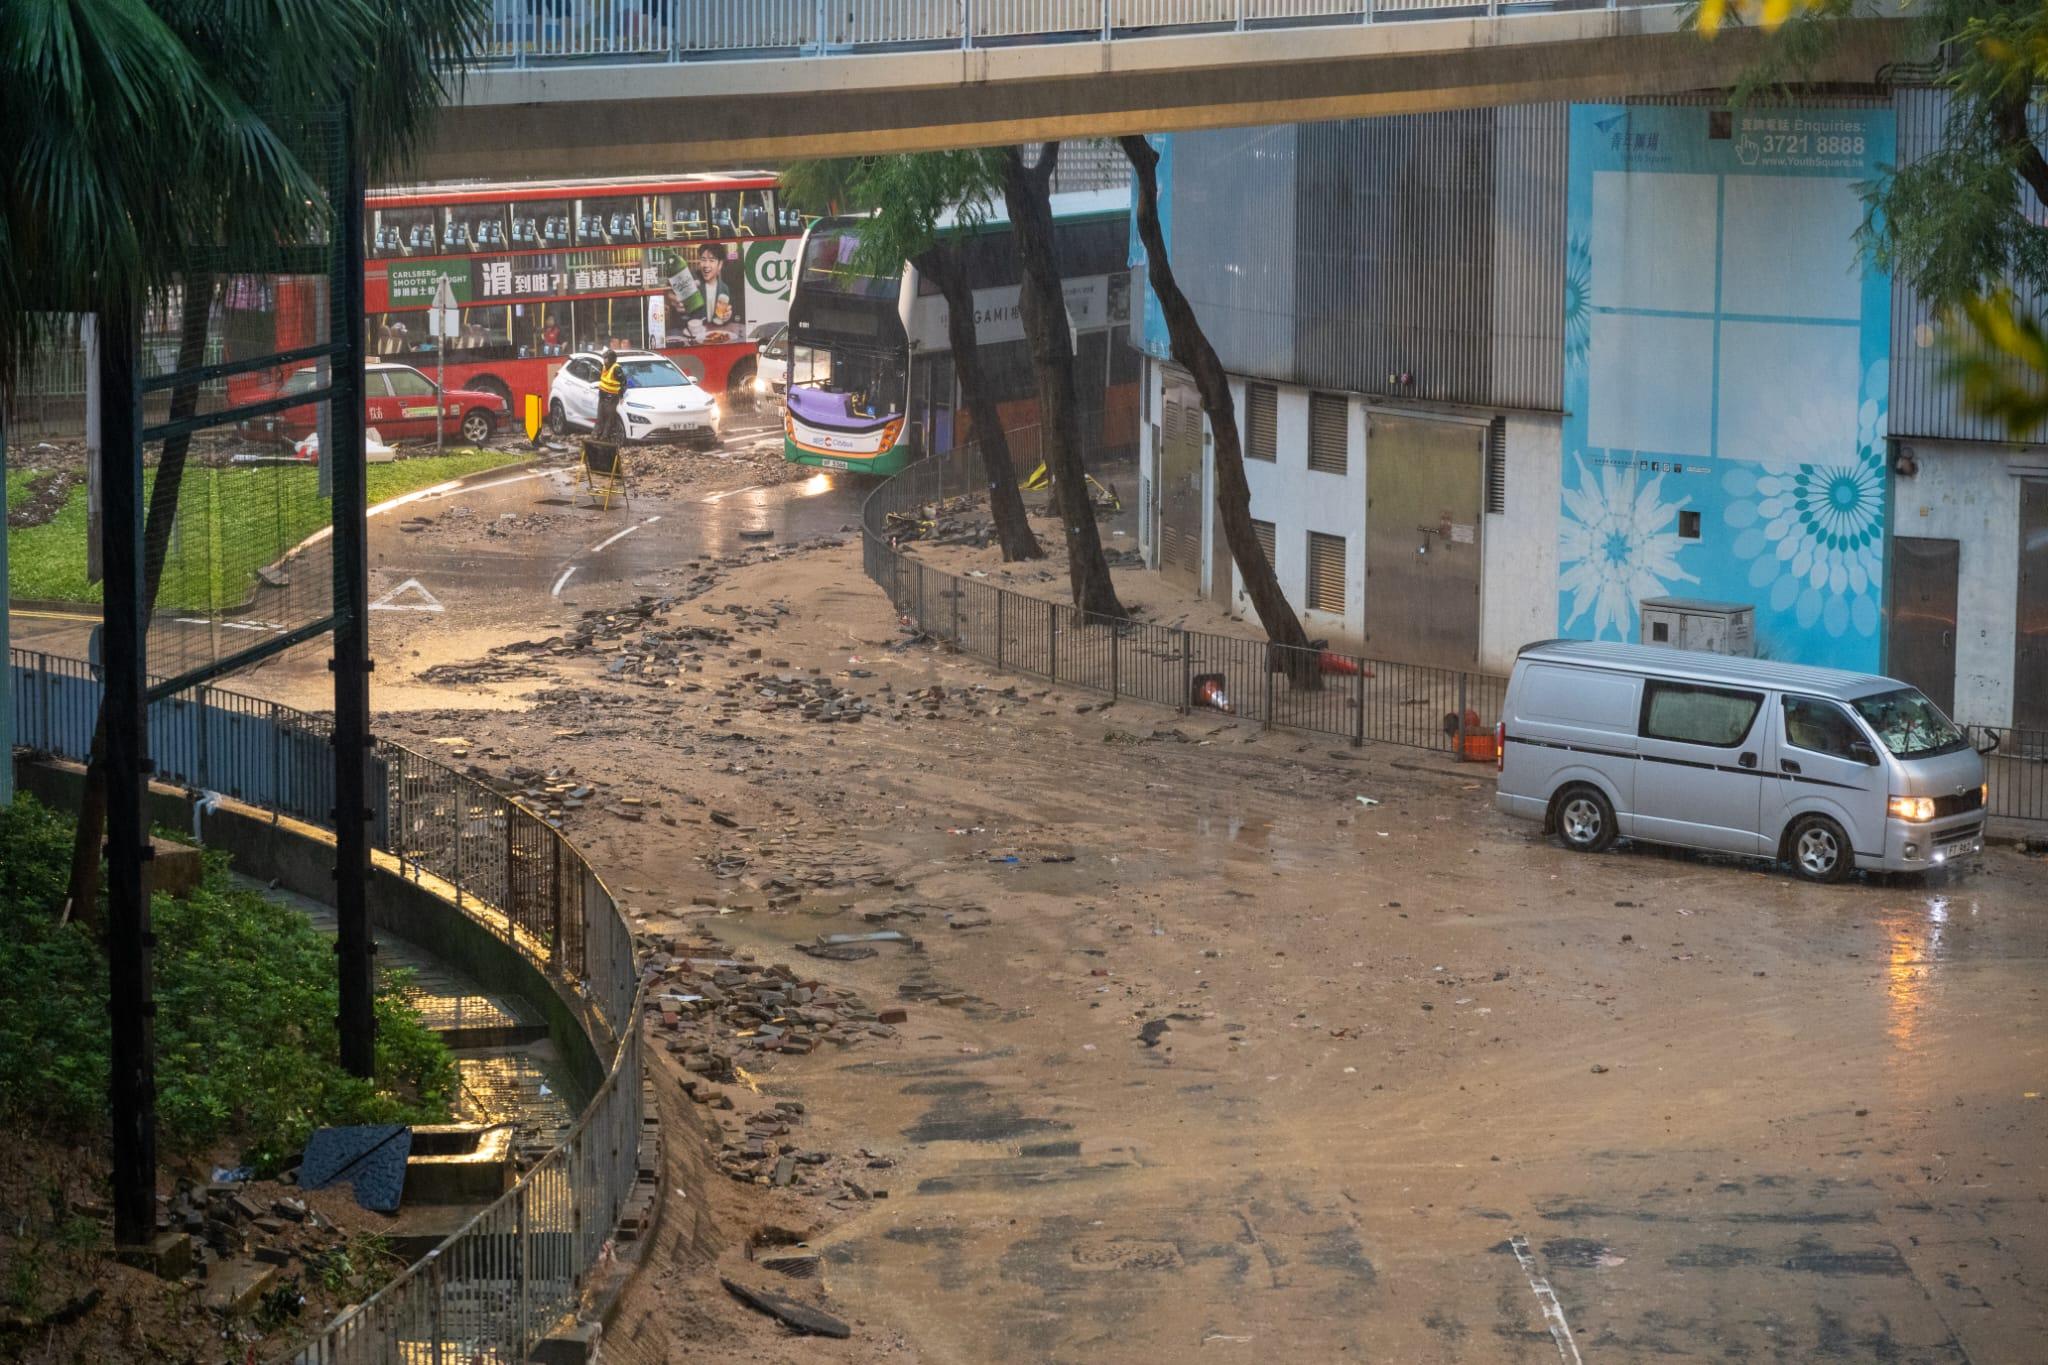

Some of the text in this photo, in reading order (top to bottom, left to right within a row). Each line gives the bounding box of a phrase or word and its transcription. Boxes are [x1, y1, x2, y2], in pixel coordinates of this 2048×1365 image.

[1794, 119, 1867, 133] Enquiries:
[1763, 135, 1865, 155] 3721 8888
[393, 269, 437, 279] CARLSBERG
[575, 266, 659, 290] 直達滿足感
[393, 278, 427, 287] SMOOTH
